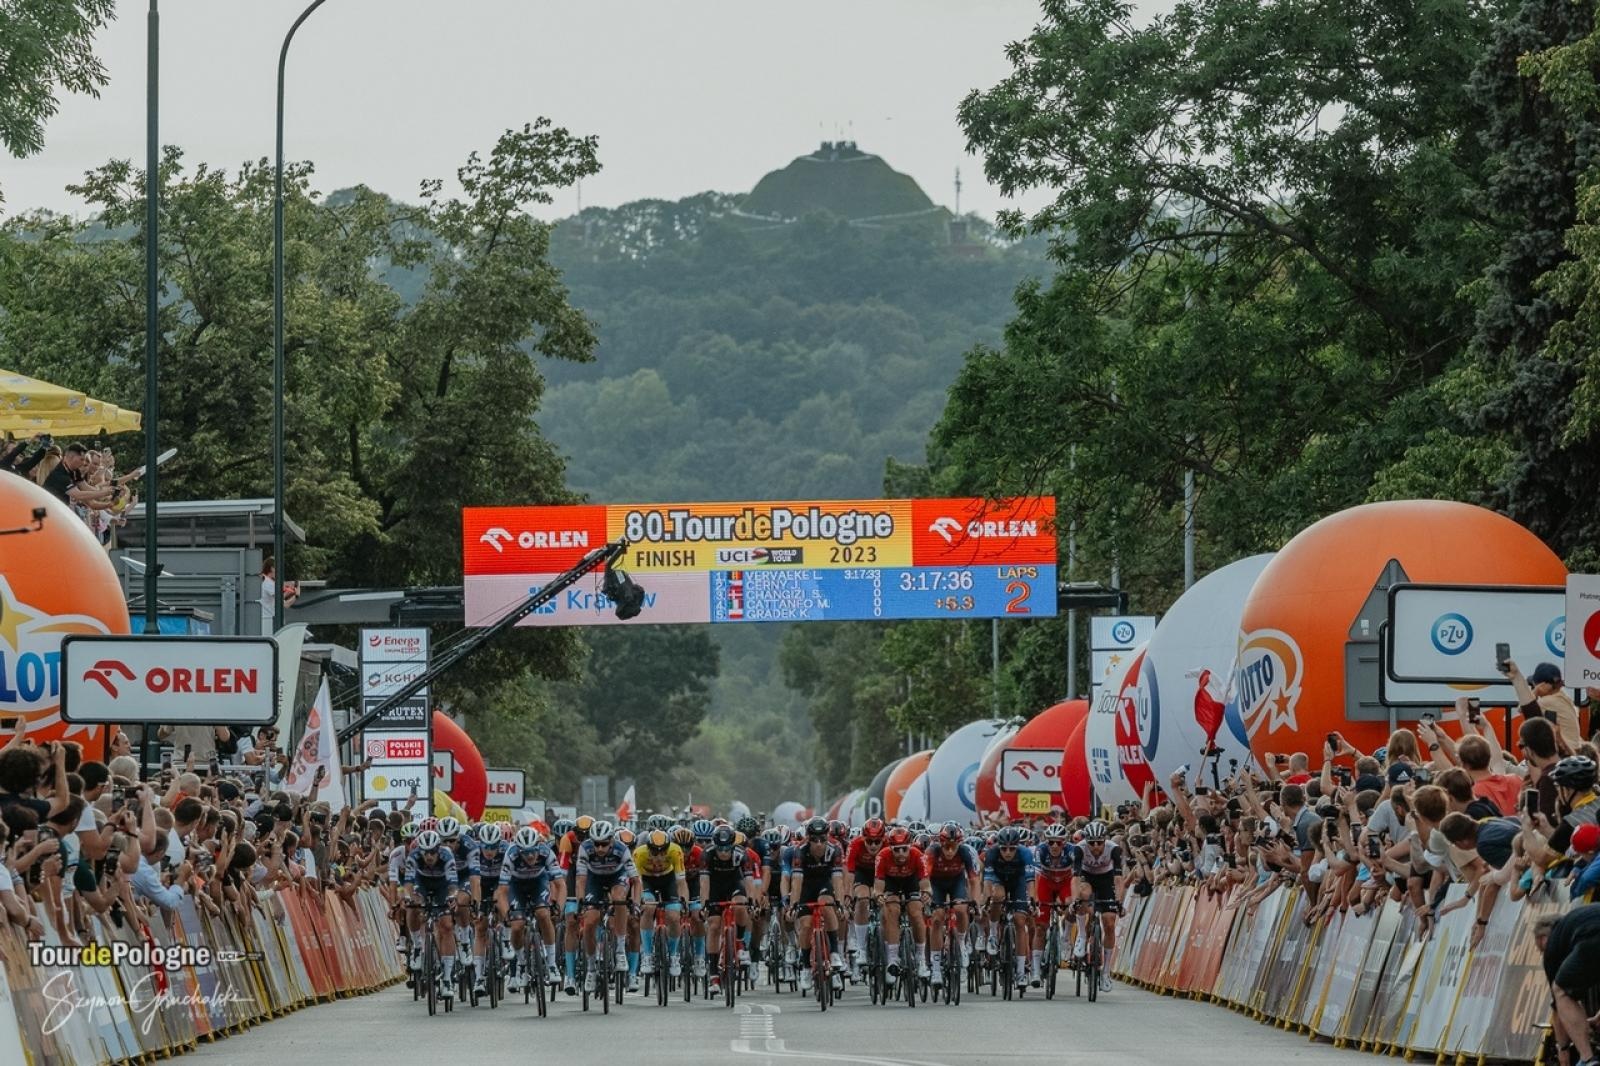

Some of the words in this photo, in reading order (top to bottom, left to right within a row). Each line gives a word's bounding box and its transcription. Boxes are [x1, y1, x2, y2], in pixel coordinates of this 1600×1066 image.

[967, 520, 1037, 538] ORLEN
[518, 531, 589, 548] ORLEN
[636, 550, 695, 566] FINISH
[719, 550, 748, 563] UCI
[830, 546, 877, 563] 2023
[746, 571, 809, 580] VERVAEKE
[997, 567, 1038, 579] LAPS
[900, 571, 973, 591] 3:17:36
[746, 590, 806, 600] CHANGIZI
[1005, 581, 1031, 613] 2
[746, 599, 813, 609] CATTANEO
[934, 596, 974, 610] +5.3
[746, 609, 796, 619] GRADEK
[1441, 625, 1464, 643] PZU
[384, 636, 420, 647] Energa
[0, 650, 61, 702] LOT
[145, 667, 257, 693] ORLEN
[1241, 654, 1273, 713] OTTO
[389, 707, 424, 716] RUTEX
[390, 776, 421, 787] onet
[489, 783, 516, 794] LEN
[1021, 798, 1049, 809] 25m
[485, 812, 508, 822] 50m
